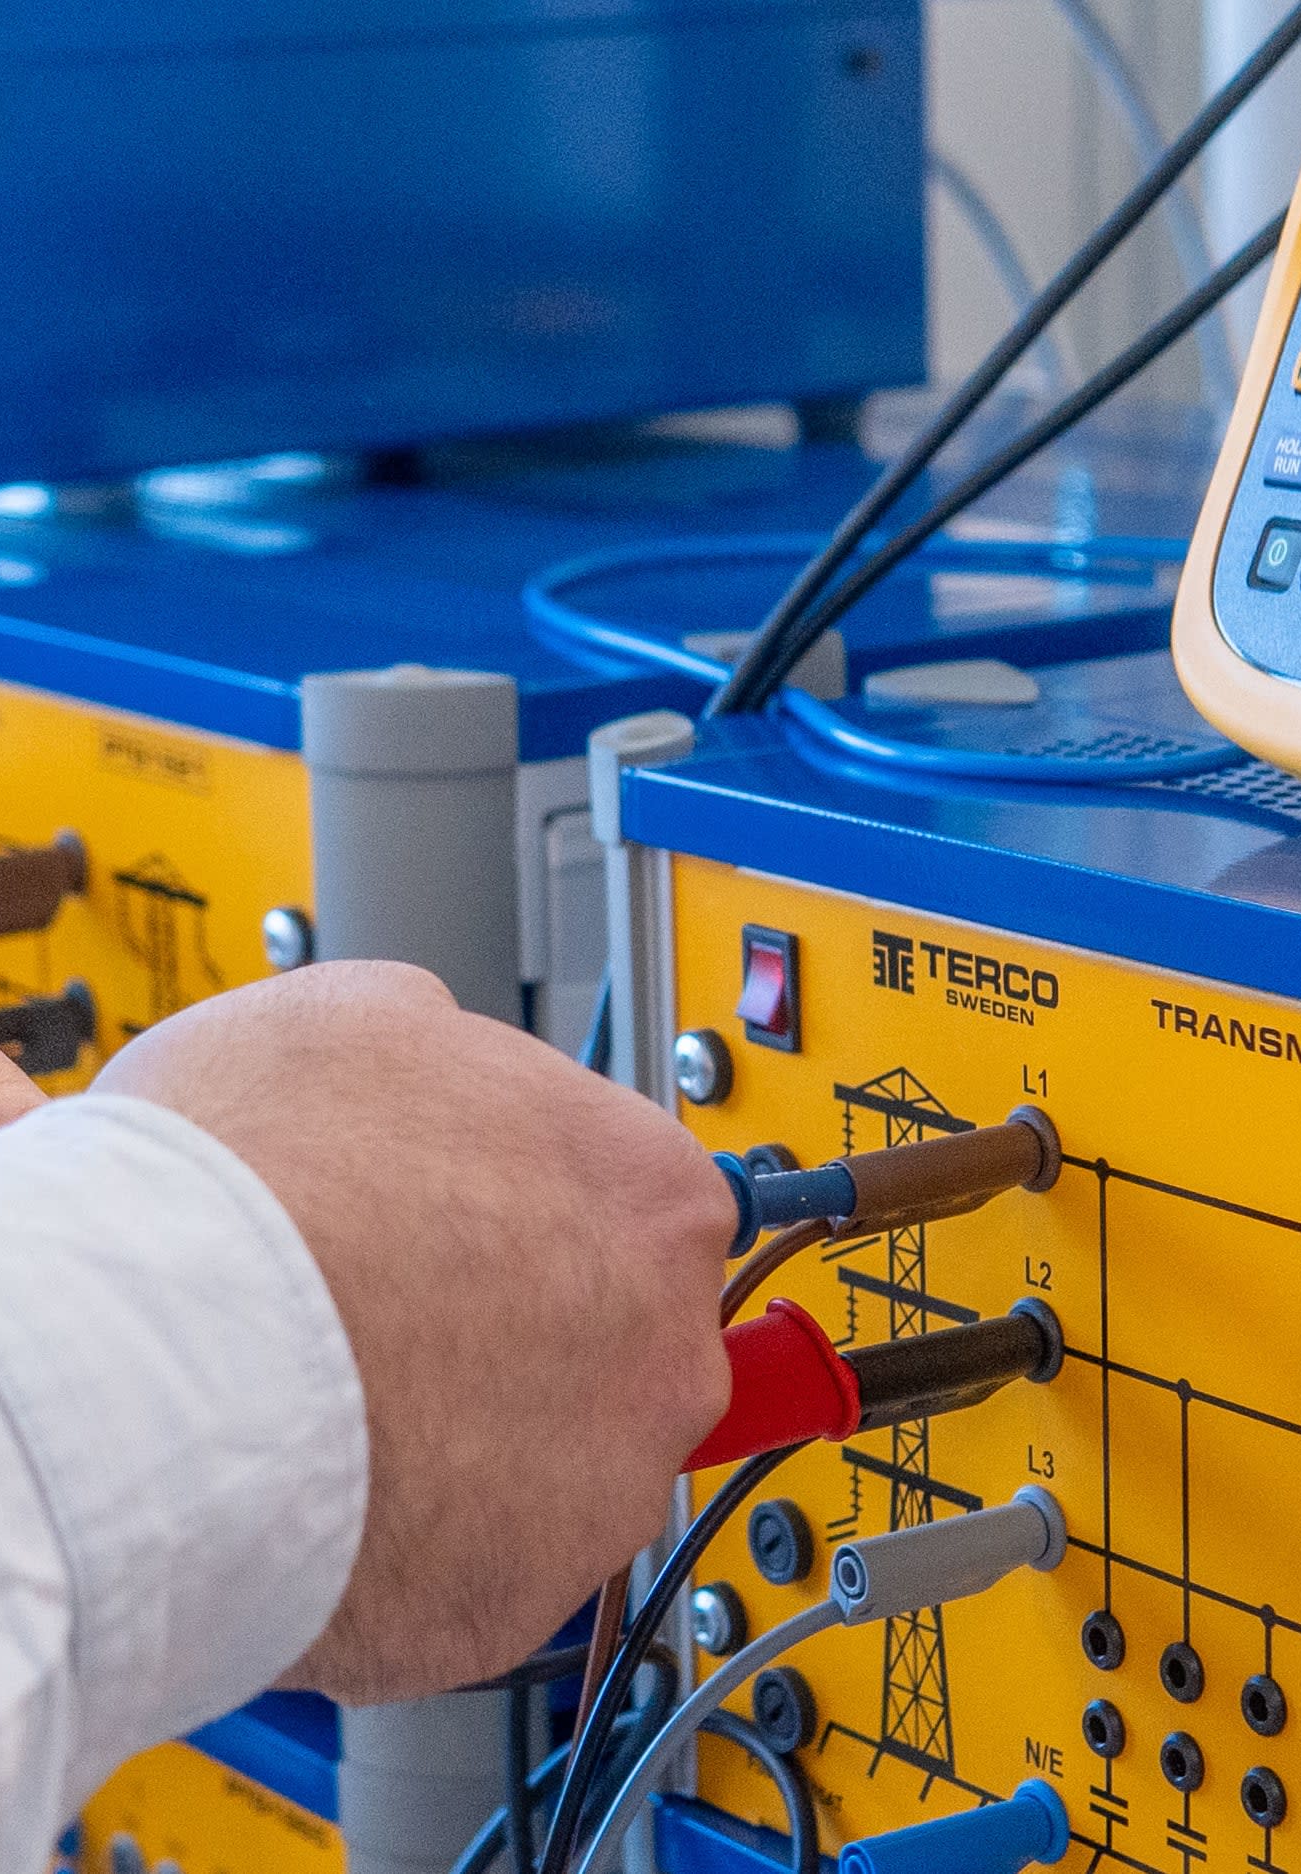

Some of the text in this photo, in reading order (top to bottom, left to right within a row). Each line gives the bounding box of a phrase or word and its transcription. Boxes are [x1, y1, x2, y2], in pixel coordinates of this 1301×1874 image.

[1274, 457, 1300, 476] RUN
[919, 941, 1059, 1009] TERCO
[946, 988, 1034, 1026] SWEDEN
[1022, 1063, 1047, 1098] L1
[1025, 1255, 1052, 1292] L2
[1028, 1444, 1055, 1480] L3
[1025, 1736, 1064, 1779] N/E
